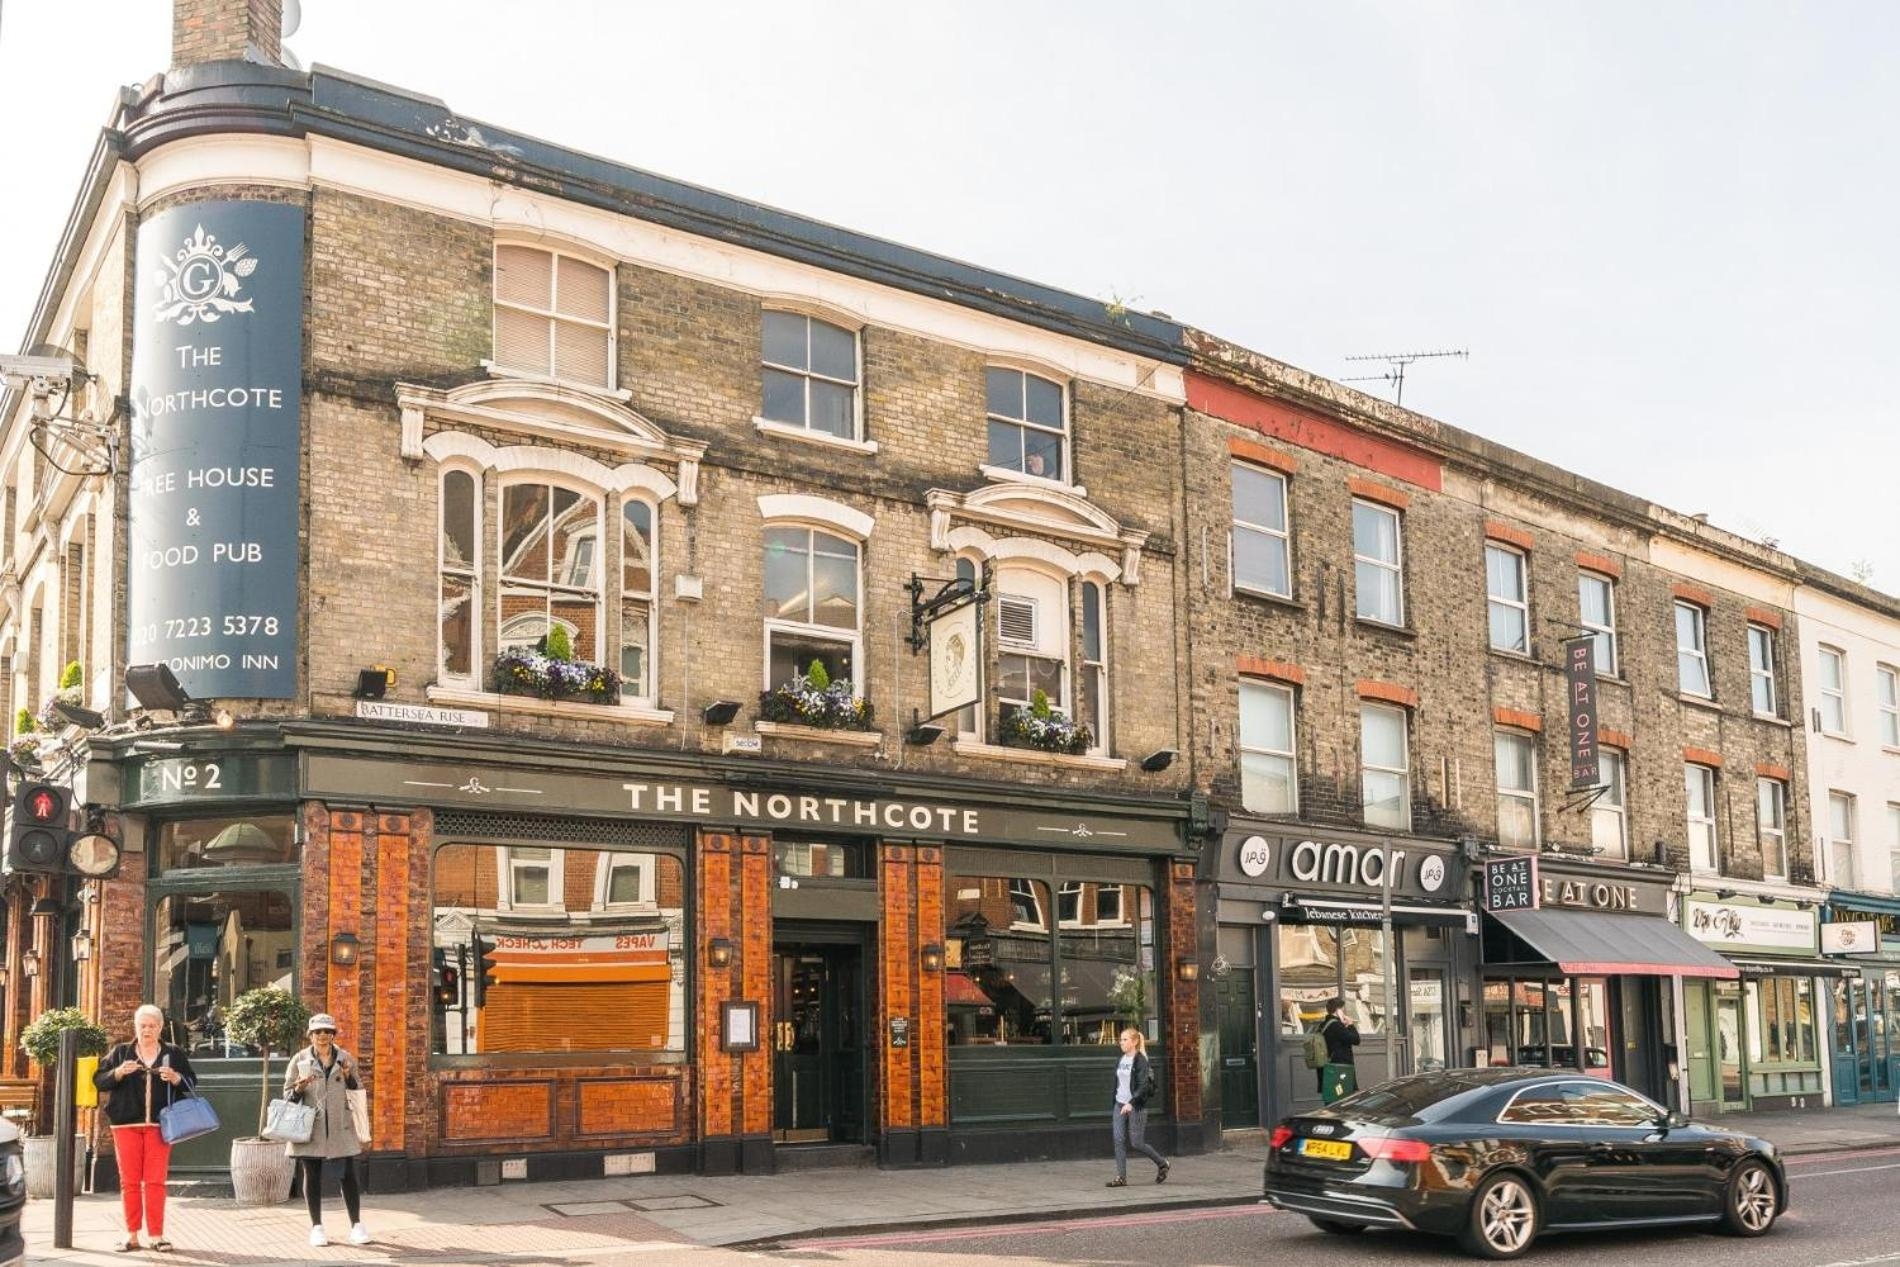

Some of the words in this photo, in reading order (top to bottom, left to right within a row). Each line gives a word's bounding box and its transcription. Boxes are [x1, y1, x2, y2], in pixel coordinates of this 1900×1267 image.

[183, 262, 214, 295] G
[176, 345, 221, 368] THE
[188, 468, 274, 488] HOUSE
[186, 508, 201, 526] &
[144, 545, 198, 570] OOD
[213, 543, 262, 563] PUB
[165, 616, 212, 640] 7223
[223, 615, 279, 636] 5378
[161, 654, 230, 673] ONIMO
[242, 655, 278, 670] INN
[1574, 648, 1587, 672] BE
[1575, 682, 1589, 706] AT
[361, 702, 434, 721] BATTERSEA
[440, 711, 465, 724] RISE
[1577, 714, 1591, 758] ONE
[204, 764, 222, 789] 2
[1574, 767, 1597, 779] BAR
[623, 783, 710, 814] THE
[734, 791, 979, 834] NORTHCOTE
[1291, 840, 1405, 887] amar
[1492, 863, 1505, 874] BE
[1511, 861, 1527, 871] AT
[1492, 872, 1527, 887] ONE
[1493, 892, 1528, 908] BAR
[1542, 879, 1553, 901] E
[1563, 881, 1587, 902] AT
[1595, 884, 1638, 909] ONE
